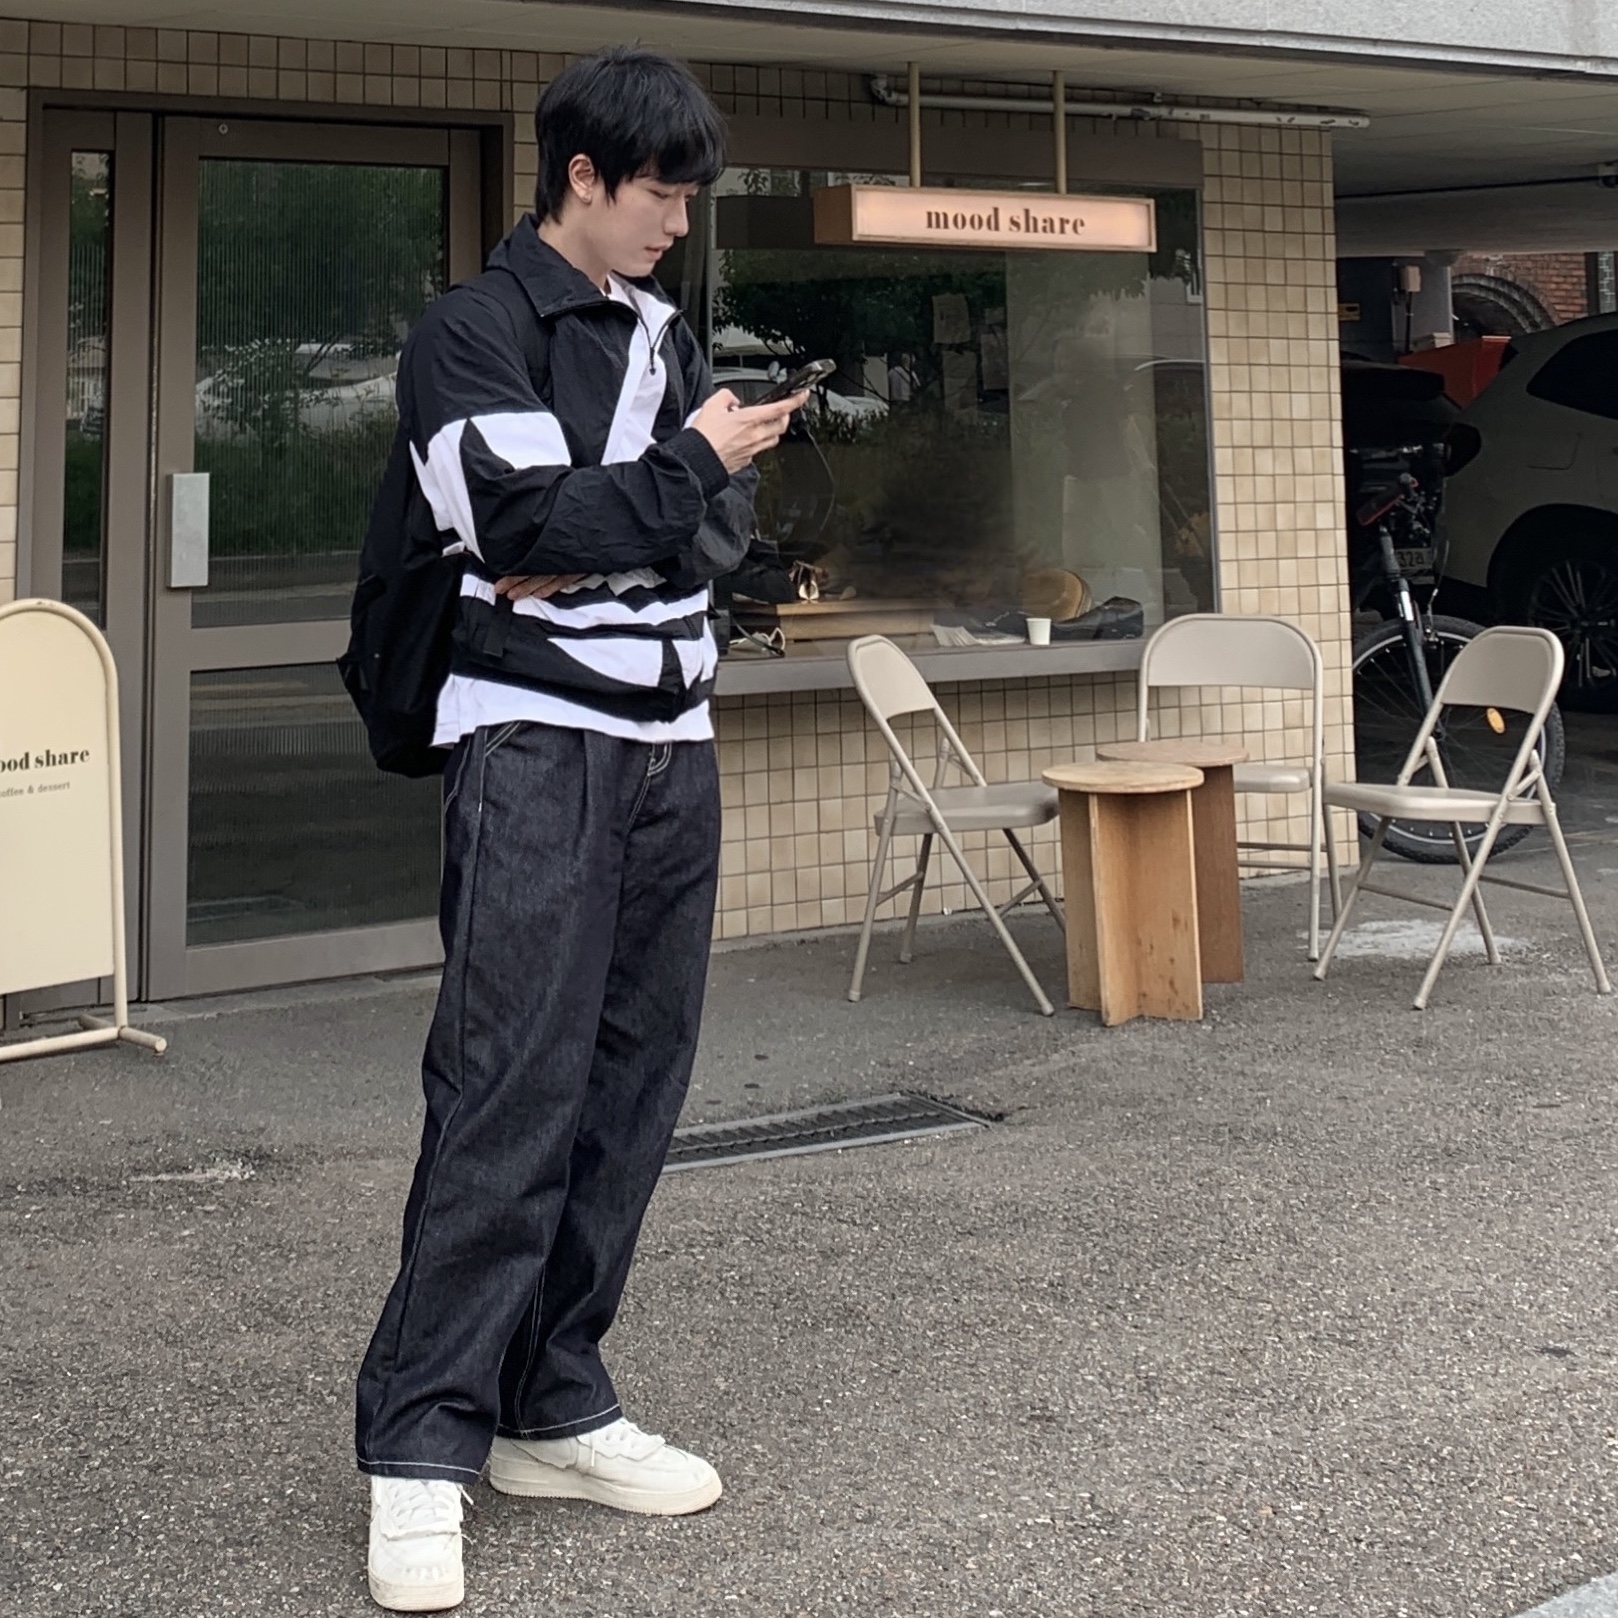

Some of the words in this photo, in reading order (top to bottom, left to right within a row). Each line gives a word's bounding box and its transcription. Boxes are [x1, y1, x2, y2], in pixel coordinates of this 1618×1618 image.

[926, 206, 1000, 232] mood
[1008, 208, 1085, 235] share
[34, 749, 90, 769] share
[0, 786, 24, 798] offee
[27, 785, 34, 795] &
[37, 781, 71, 793] dessert
